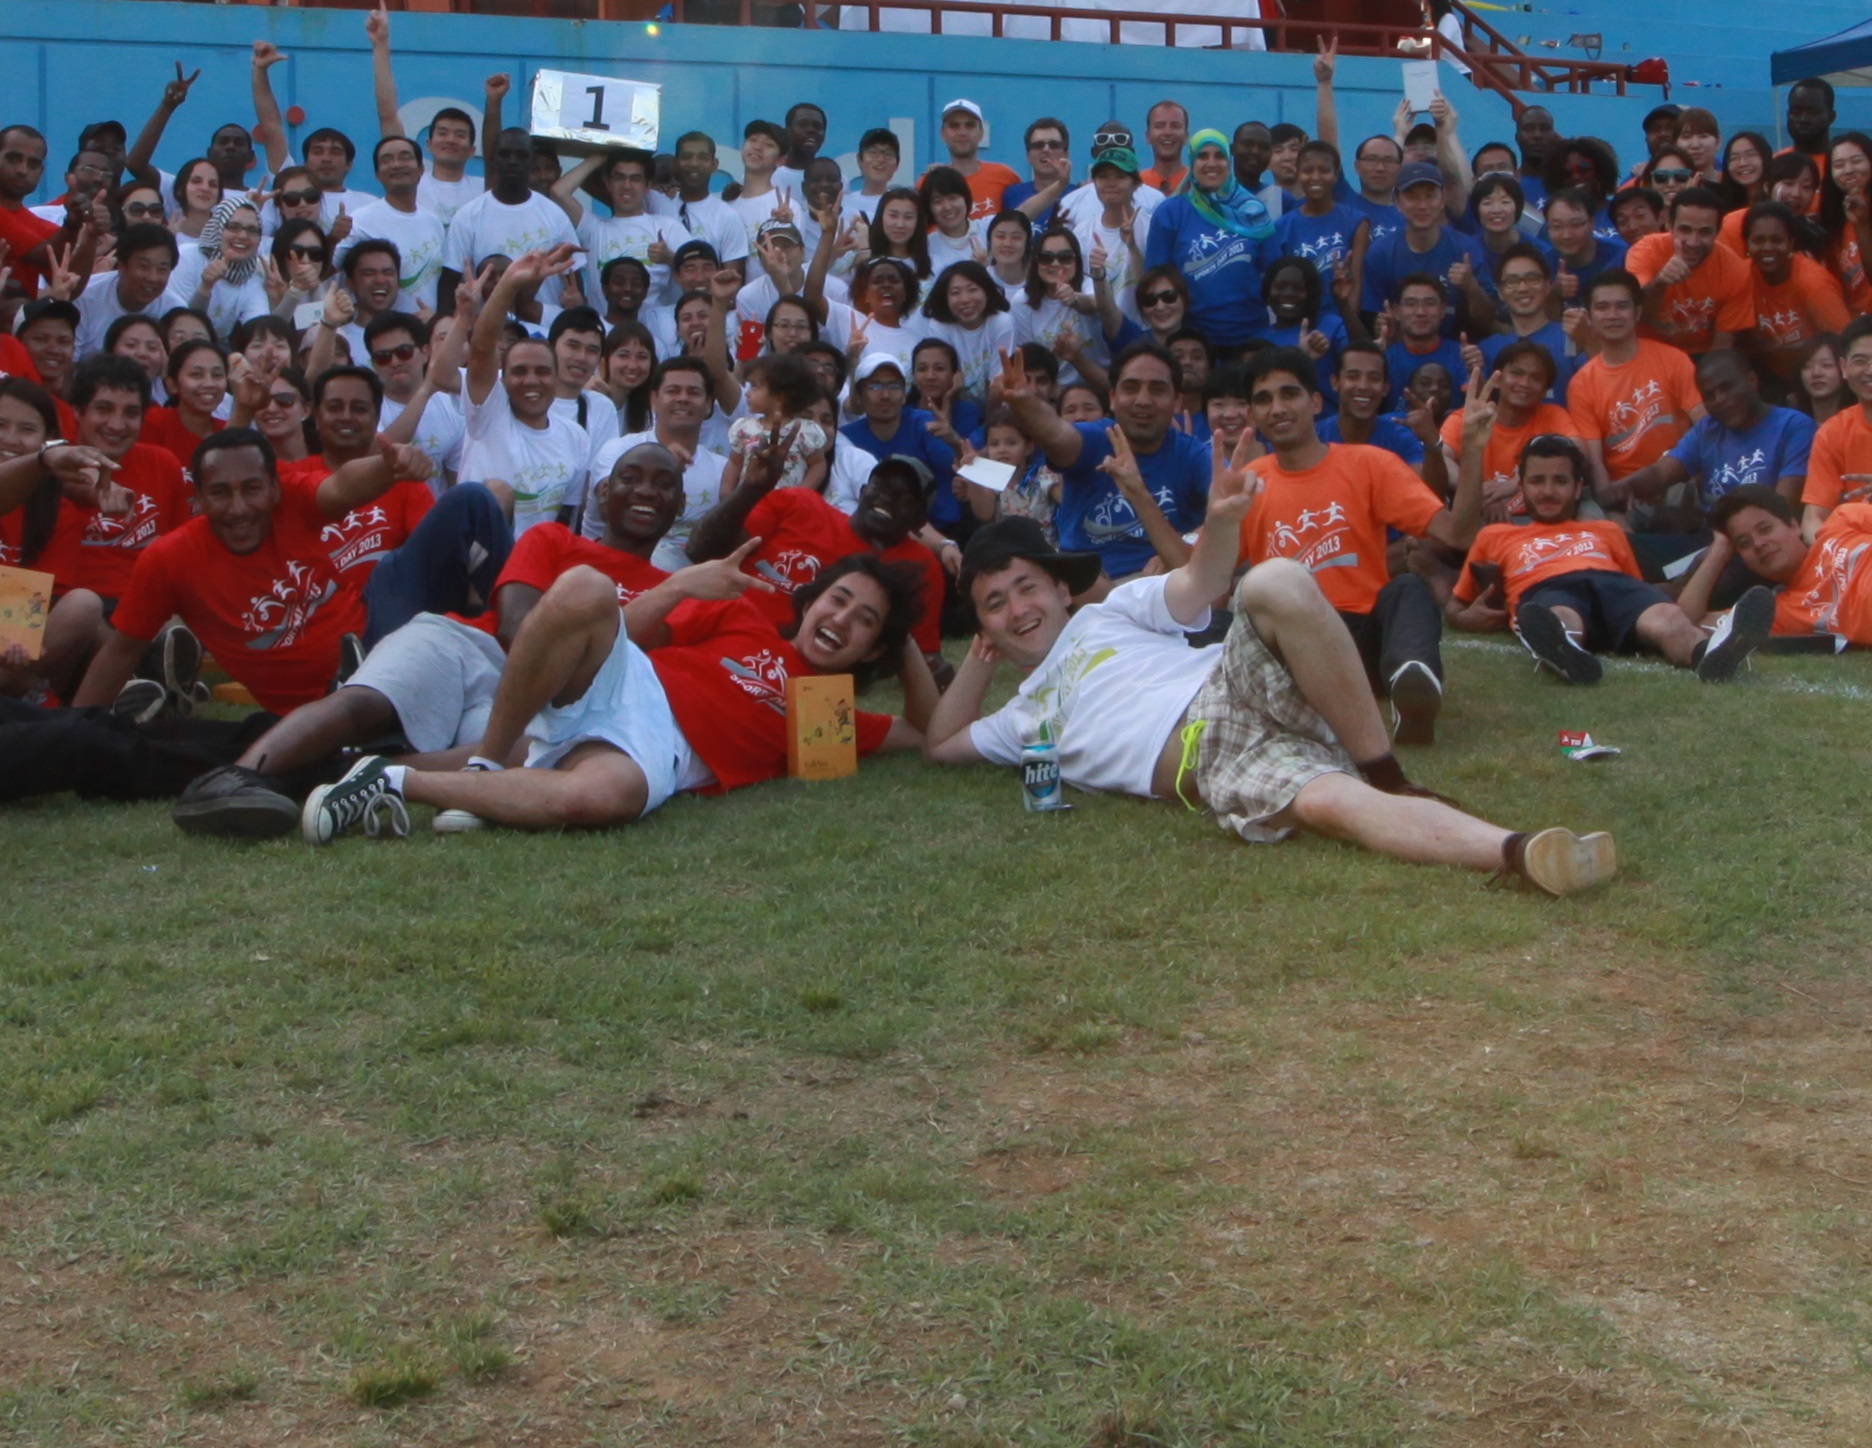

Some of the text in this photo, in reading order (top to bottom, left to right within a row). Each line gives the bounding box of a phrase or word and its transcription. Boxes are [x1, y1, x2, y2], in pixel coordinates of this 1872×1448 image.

[583, 85, 610, 131] 1
[135, 519, 156, 542] 2013
[339, 533, 382, 568] DAY 2013
[1316, 543, 1341, 561] 2013
[1572, 540, 1595, 556] 2013
[1024, 762, 1060, 785] hite
